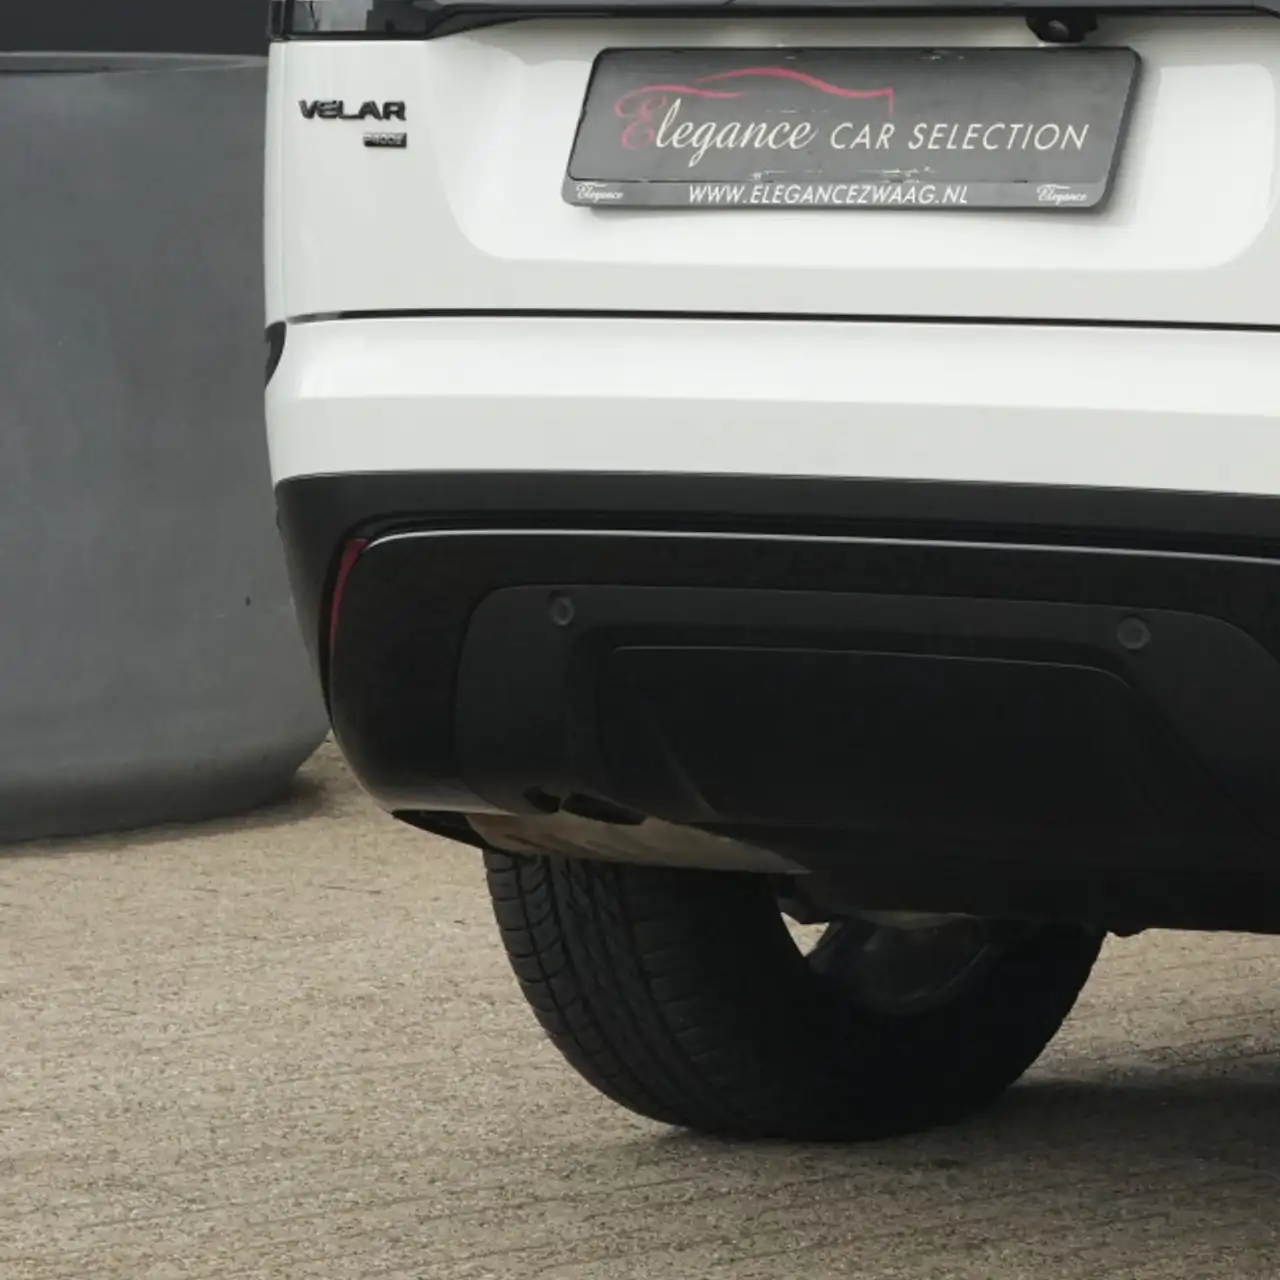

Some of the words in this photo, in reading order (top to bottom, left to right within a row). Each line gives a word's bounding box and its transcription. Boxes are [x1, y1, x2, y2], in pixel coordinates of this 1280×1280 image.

[298, 99, 407, 121] VELAR
[614, 84, 819, 168] Elegance
[830, 122, 896, 150] CAR
[907, 123, 1090, 152] SELECTION
[688, 184, 968, 205] WWW.ELEGANCEZWAAG.NL
